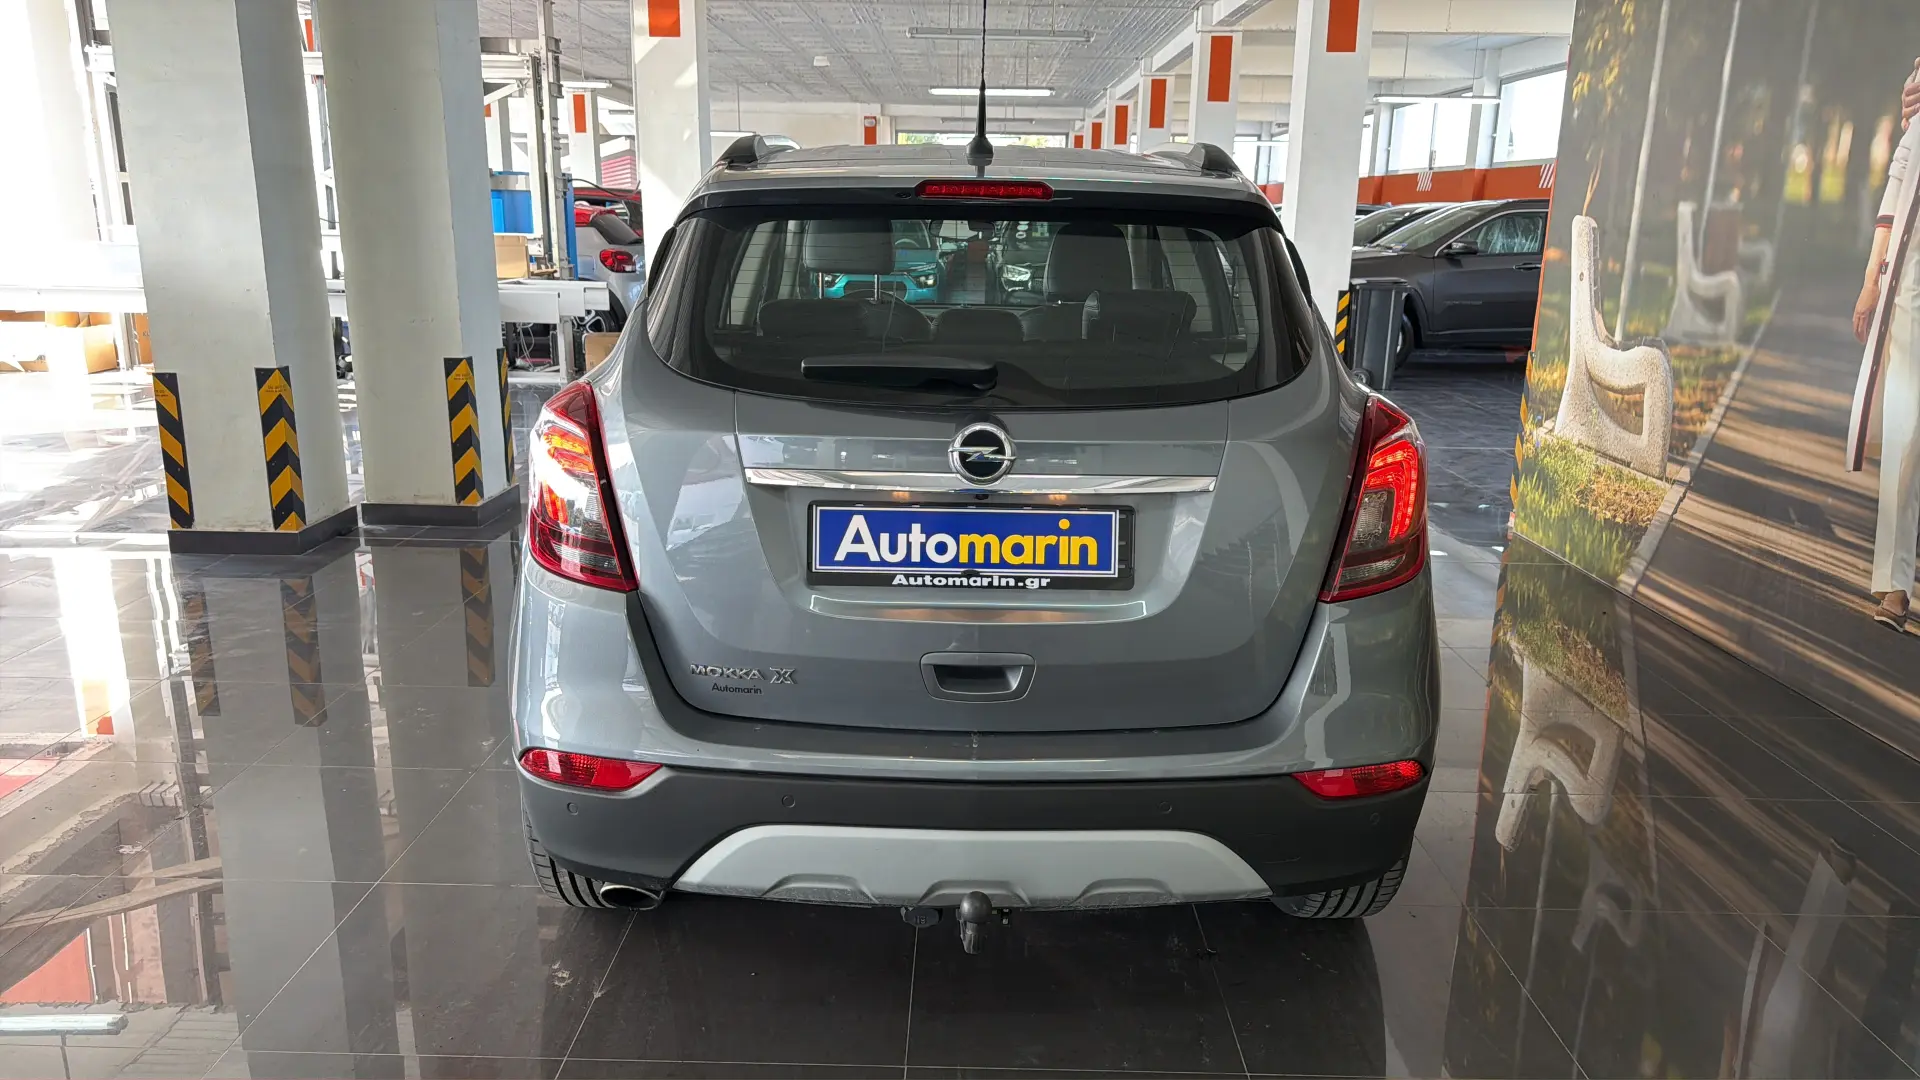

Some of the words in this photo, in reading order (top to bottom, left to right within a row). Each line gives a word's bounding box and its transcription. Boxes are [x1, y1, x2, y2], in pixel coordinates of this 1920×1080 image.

[834, 514, 1098, 565] Automarin
[892, 574, 1051, 589] Automarin.gr
[690, 664, 765, 680] MOKKA
[769, 667, 797, 684] X
[711, 682, 762, 694] Automarin
